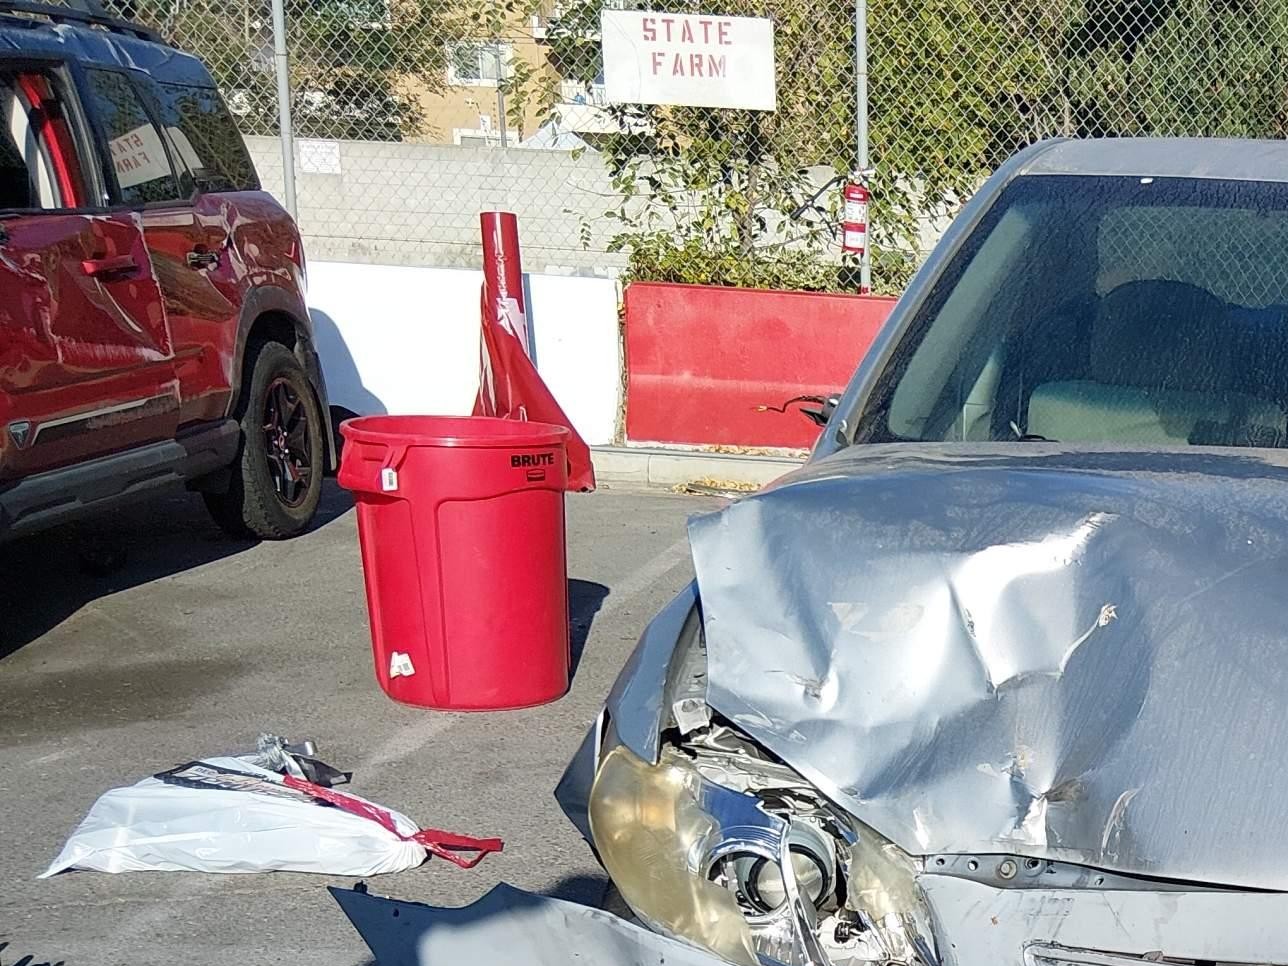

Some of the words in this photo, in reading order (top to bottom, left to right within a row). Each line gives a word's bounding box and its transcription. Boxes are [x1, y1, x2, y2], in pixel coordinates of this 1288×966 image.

[642, 18, 732, 45] STATE
[652, 52, 727, 78] FARM
[511, 453, 554, 467] BRUTE
